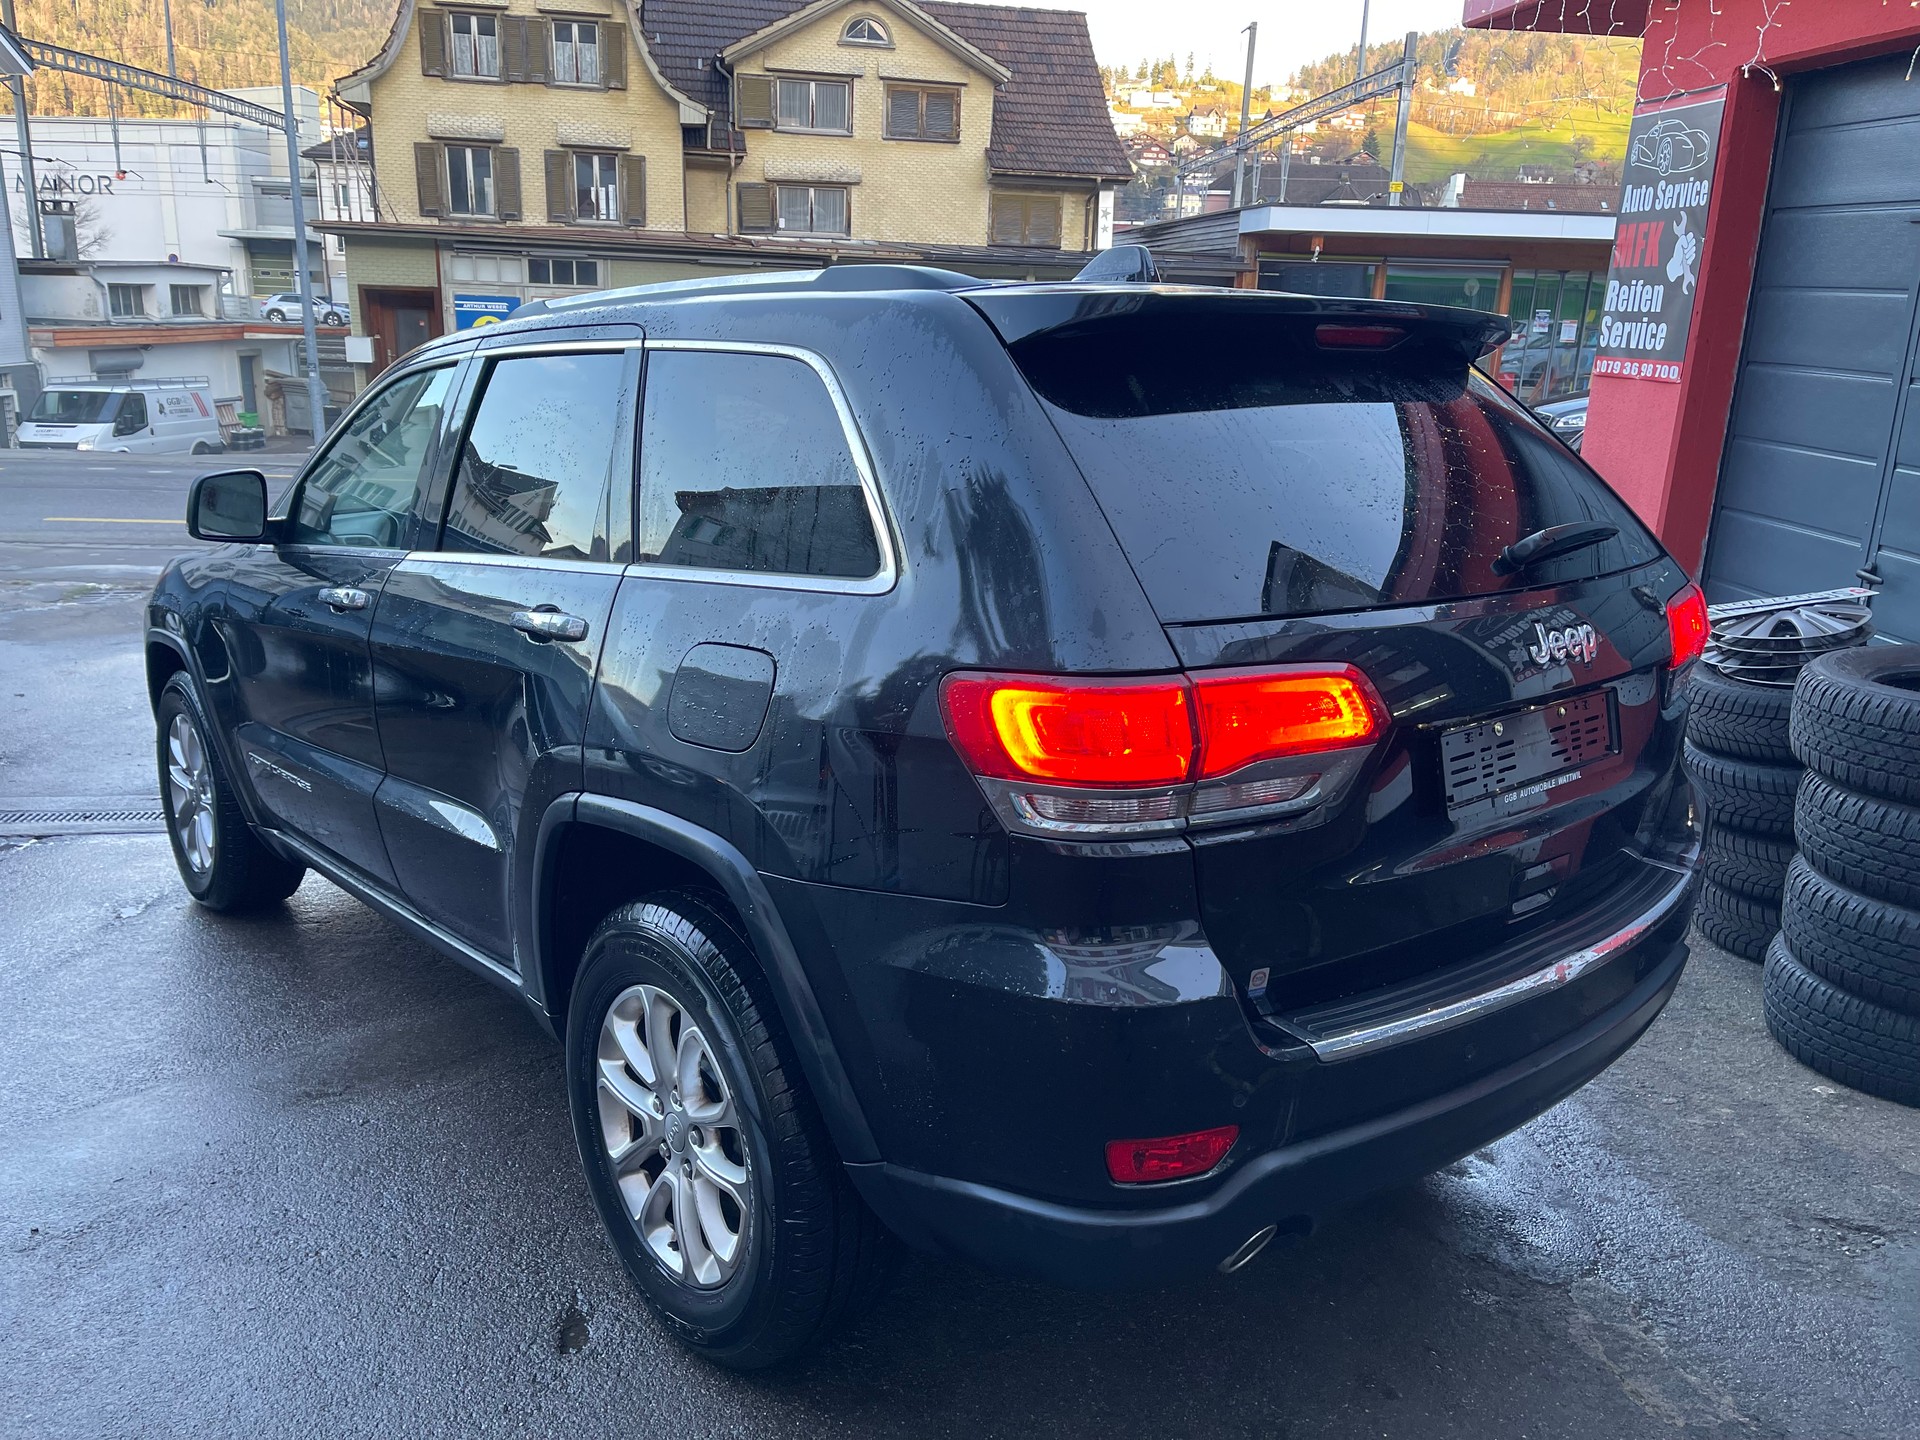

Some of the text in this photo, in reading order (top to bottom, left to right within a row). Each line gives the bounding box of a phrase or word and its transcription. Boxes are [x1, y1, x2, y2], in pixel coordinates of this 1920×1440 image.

[1621, 177, 1709, 214] Auto Service
[1604, 280, 1664, 313] Reifen
[1600, 316, 1668, 351] Service
[1529, 621, 1597, 664] Jeep
[1504, 770, 1582, 803] GGB AUTOMOBILE WATTWIL
